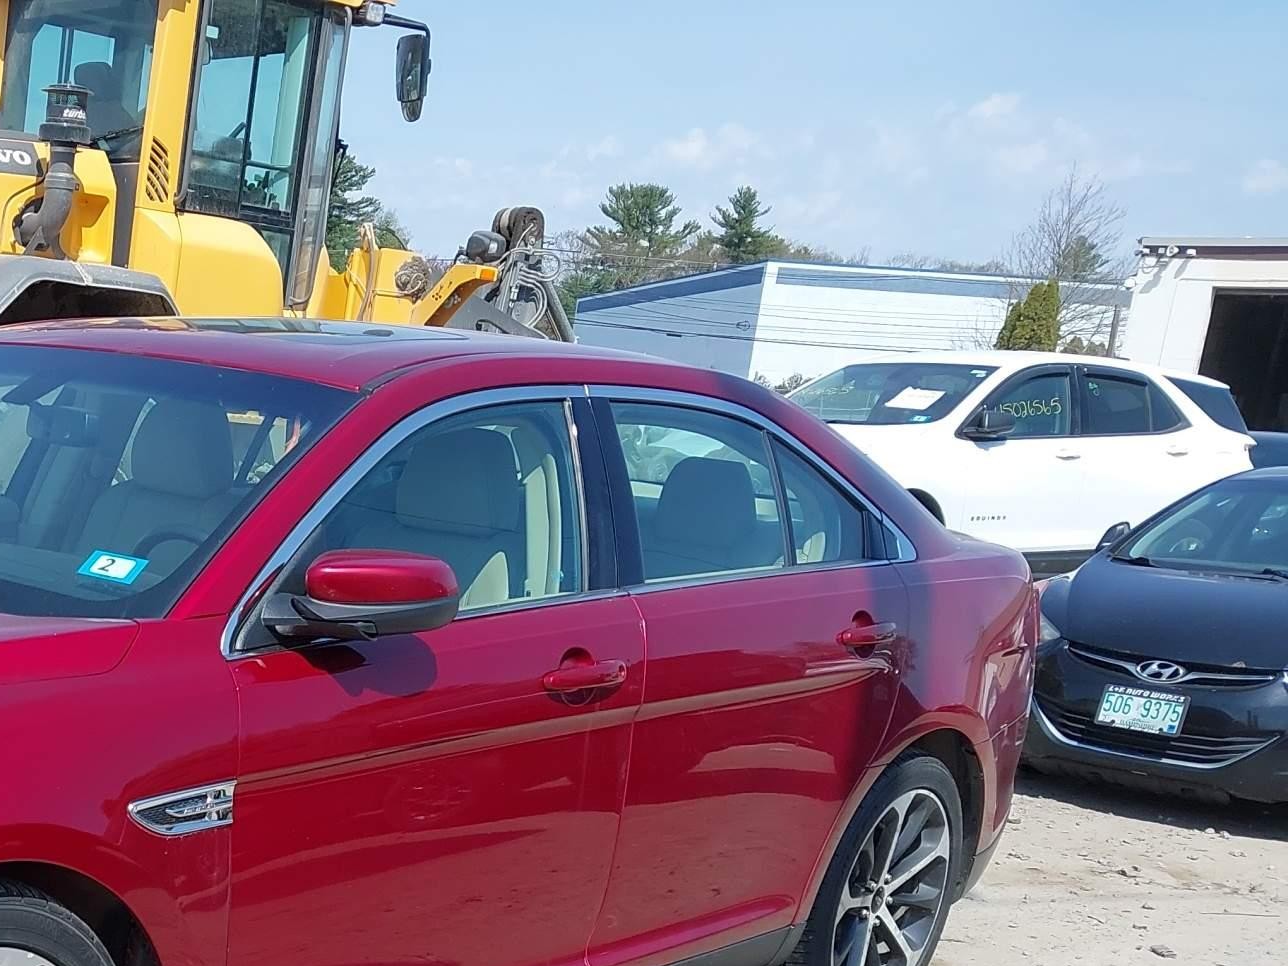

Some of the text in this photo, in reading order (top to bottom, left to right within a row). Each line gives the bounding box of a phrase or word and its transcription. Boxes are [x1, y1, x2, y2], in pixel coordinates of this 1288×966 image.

[97, 558, 116, 572] 2
[1125, 687, 1150, 697] AUTO
[1150, 692, 1186, 703] WORKS
[1102, 694, 1184, 723] 506 9375
